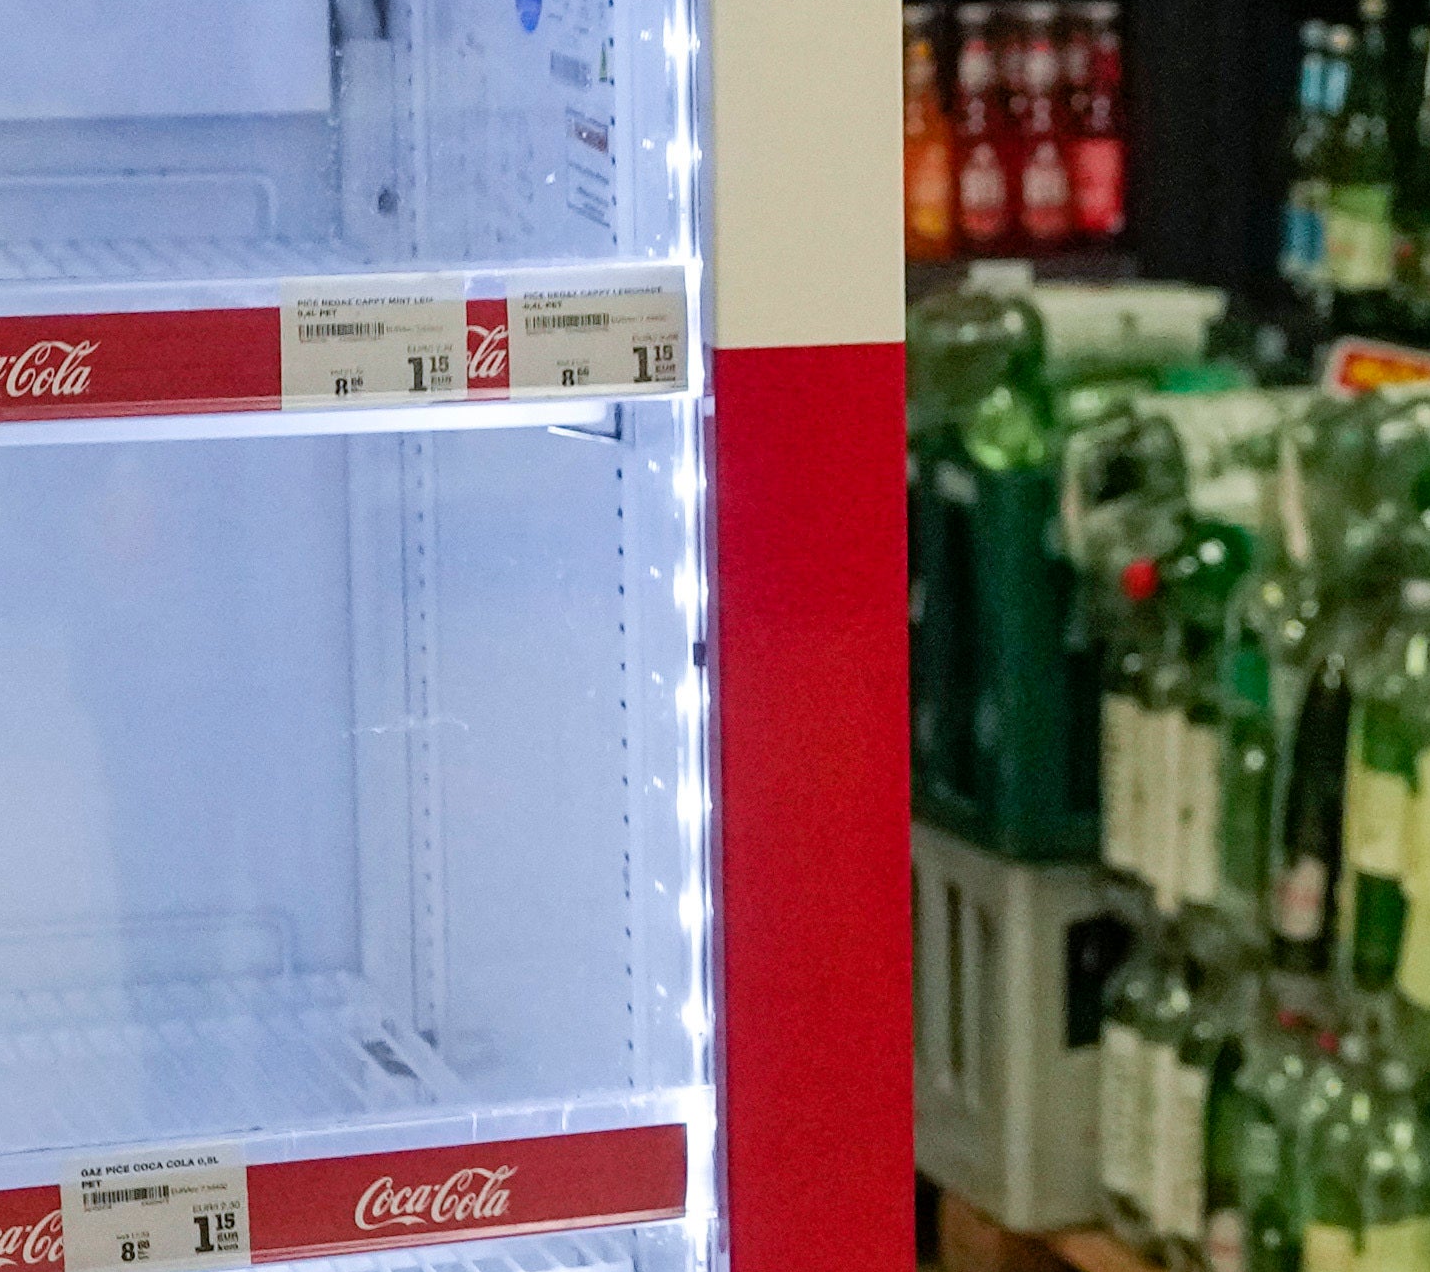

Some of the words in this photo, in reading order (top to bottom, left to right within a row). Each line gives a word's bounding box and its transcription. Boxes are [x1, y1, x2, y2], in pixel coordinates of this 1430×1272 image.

[467, 324, 510, 379] la
[633, 346, 653, 383] 1
[408, 356, 428, 392] 1
[430, 355, 450, 374] 15
[133, 1161, 164, 1172] COCA
[167, 1158, 195, 1169] COLA
[355, 1165, 518, 1230] Coca-Cola
[194, 1215, 215, 1253] 1
[215, 1212, 235, 1231] 15
[121, 1241, 136, 1262] 8
